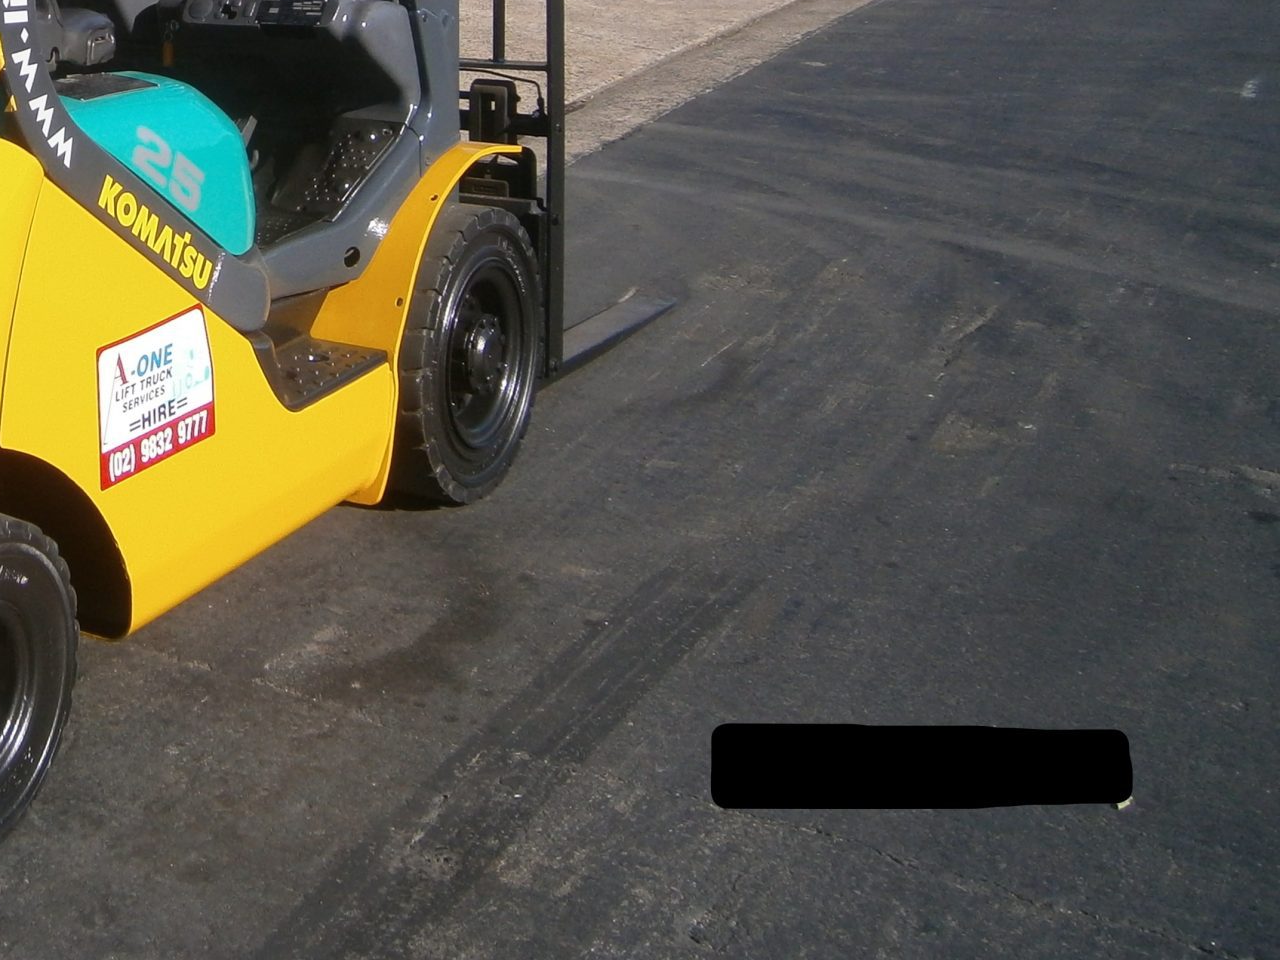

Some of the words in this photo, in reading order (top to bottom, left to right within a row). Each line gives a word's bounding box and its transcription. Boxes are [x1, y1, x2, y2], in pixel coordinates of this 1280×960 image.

[131, 124, 206, 212] 25
[97, 174, 213, 291] KOMATSU
[114, 342, 174, 388] A-ONE
[115, 383, 137, 403] LIFT
[139, 366, 174, 392] TRUCK
[122, 386, 167, 414] SERVICES
[108, 443, 136, 483] (02)
[140, 427, 173, 464] 9832
[177, 409, 209, 445] 9777
